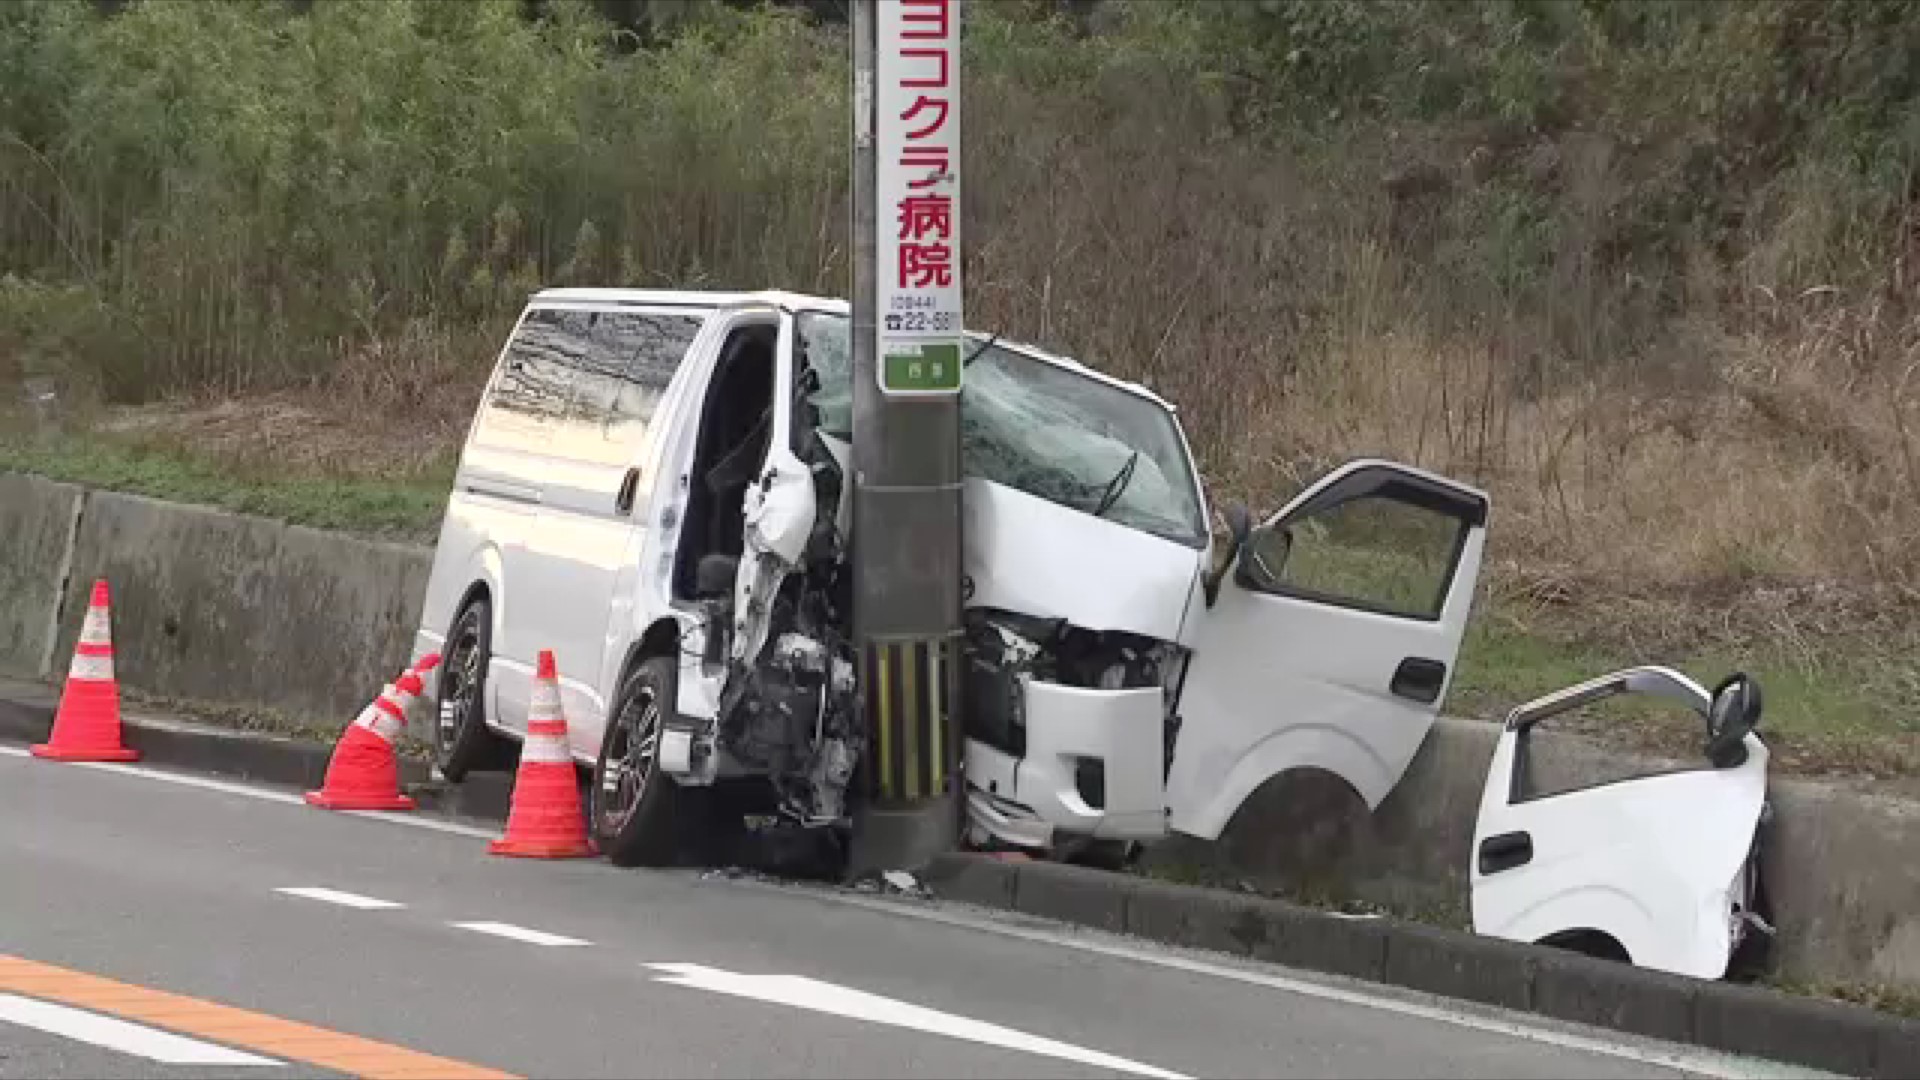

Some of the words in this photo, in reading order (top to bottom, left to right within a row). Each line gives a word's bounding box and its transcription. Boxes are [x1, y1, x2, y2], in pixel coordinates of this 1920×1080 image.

[897, 0, 952, 288] ヨコクラ病院
